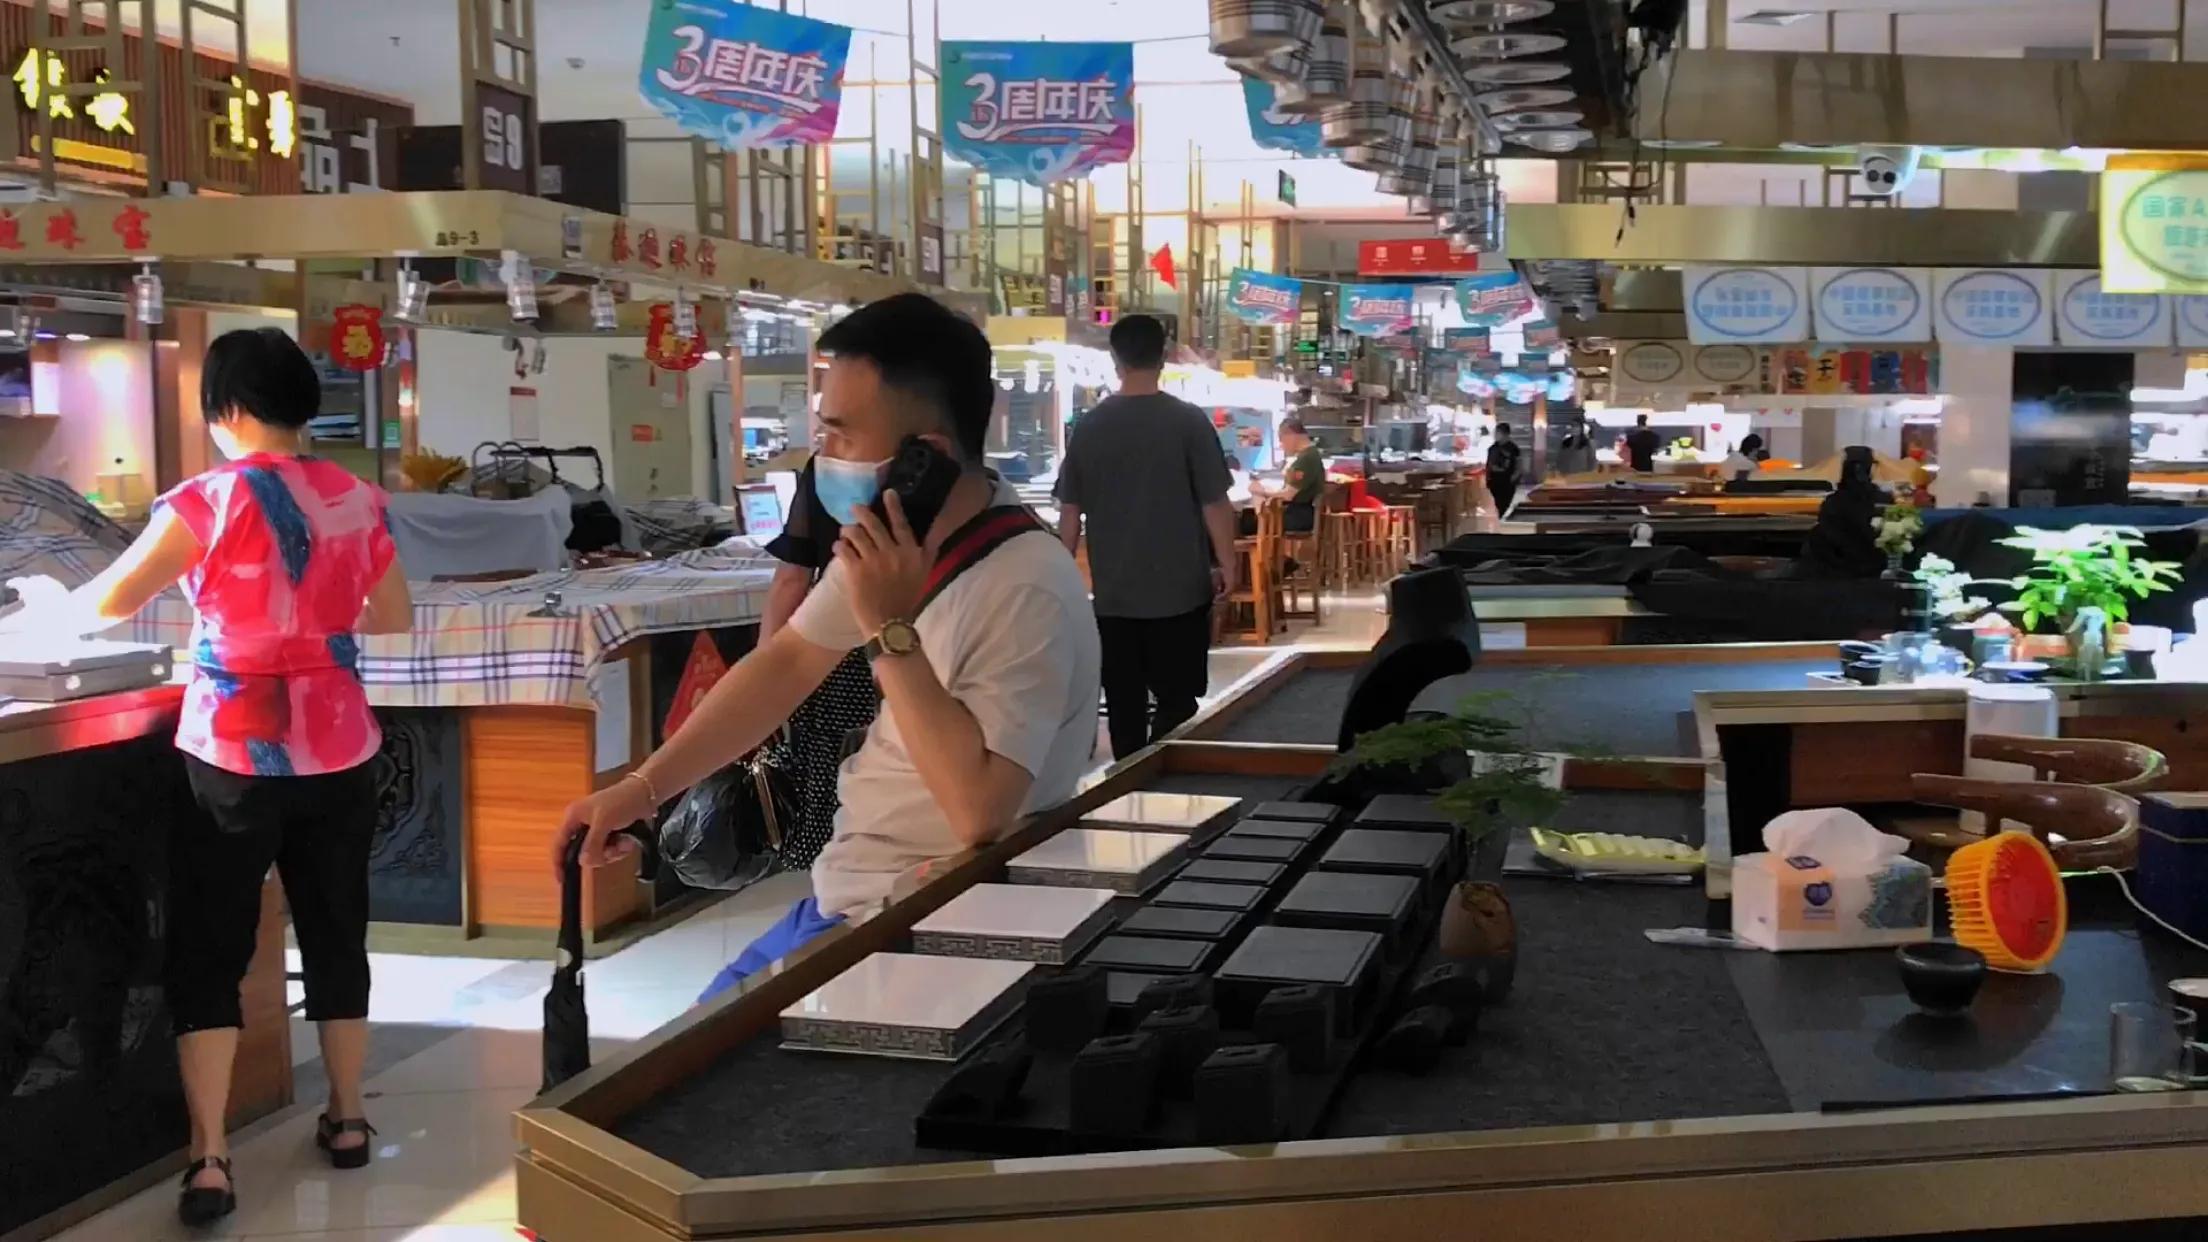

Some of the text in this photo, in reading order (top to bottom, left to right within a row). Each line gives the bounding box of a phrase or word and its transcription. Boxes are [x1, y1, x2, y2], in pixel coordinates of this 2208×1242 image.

[656, 25, 827, 99] 3周年庆
[956, 72, 1117, 139] 3周年庆
